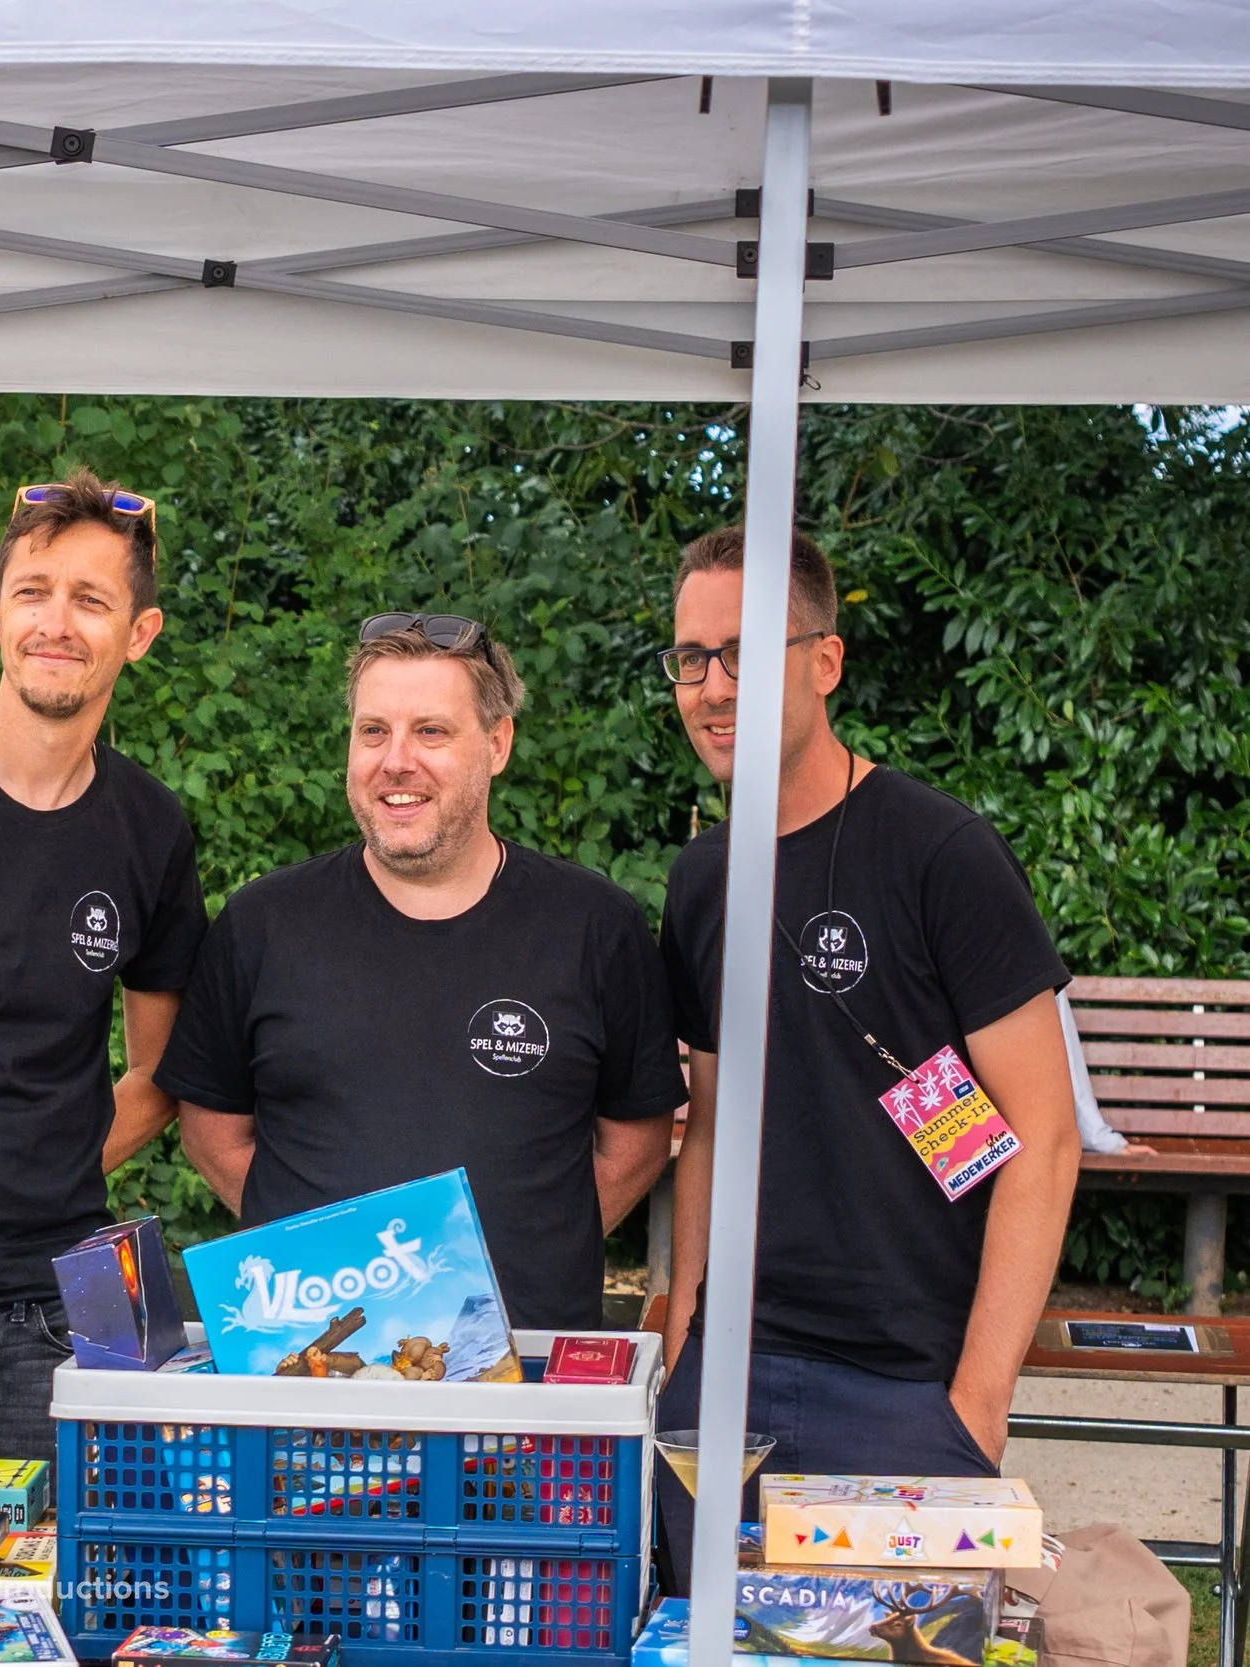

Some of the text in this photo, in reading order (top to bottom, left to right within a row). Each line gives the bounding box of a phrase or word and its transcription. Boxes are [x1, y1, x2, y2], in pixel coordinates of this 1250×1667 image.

[71, 932, 85, 945] SPEL
[87, 935, 93, 947] &
[818, 957, 827, 969] &
[470, 1038, 545, 1056] SPEL & MIZERIE
[913, 1092, 979, 1143] Summer
[948, 1136, 1017, 1191] MEDEWERKER
[889, 1535, 921, 1548] JUST
[741, 1585, 847, 1609] SCADIA
